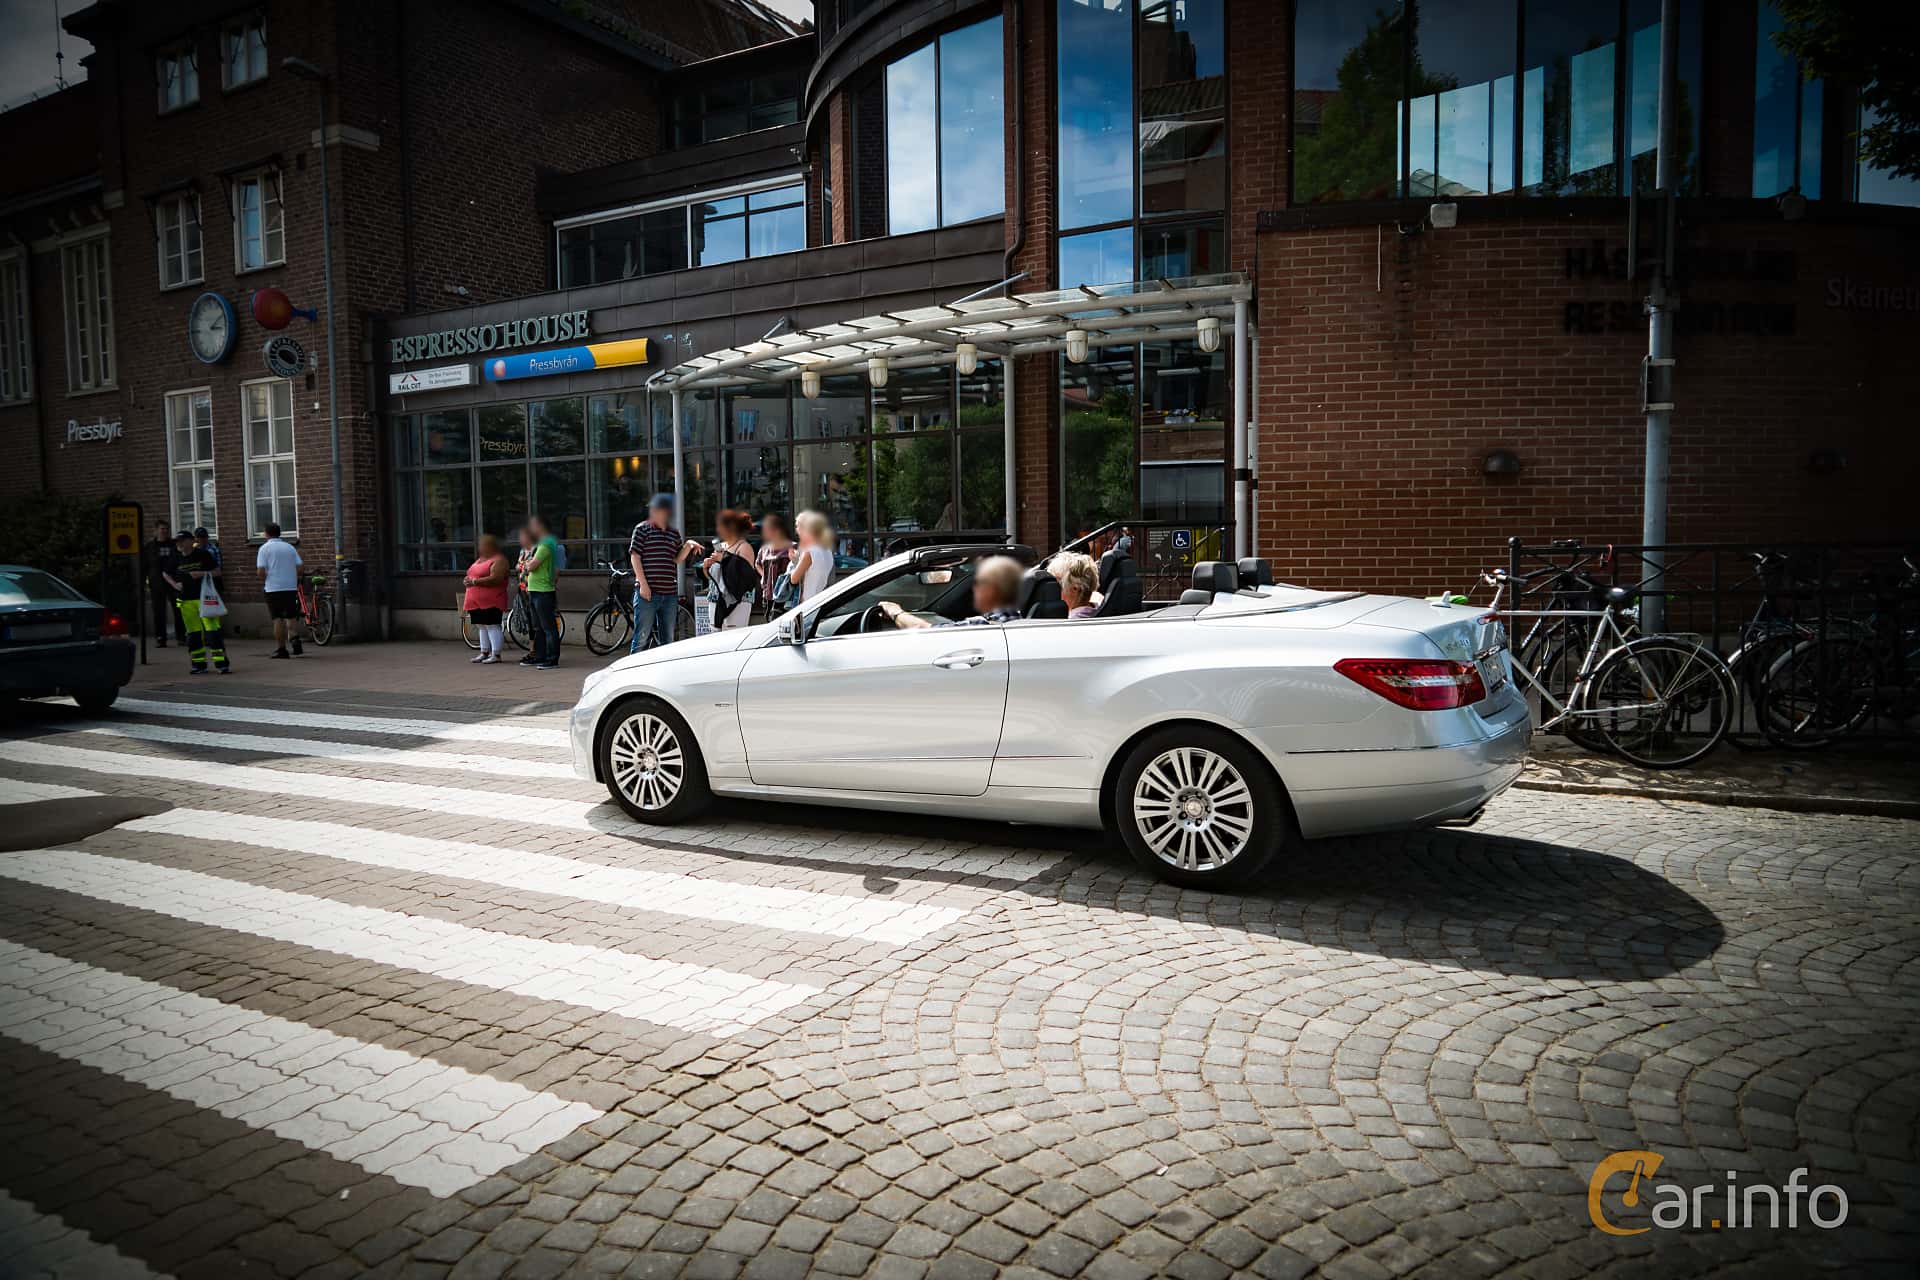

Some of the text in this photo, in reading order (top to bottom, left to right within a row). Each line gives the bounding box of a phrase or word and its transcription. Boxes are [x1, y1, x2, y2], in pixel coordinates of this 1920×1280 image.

[391, 311, 590, 363] ESPRESSO HOUSE
[529, 355, 578, 371] Pressbyrån
